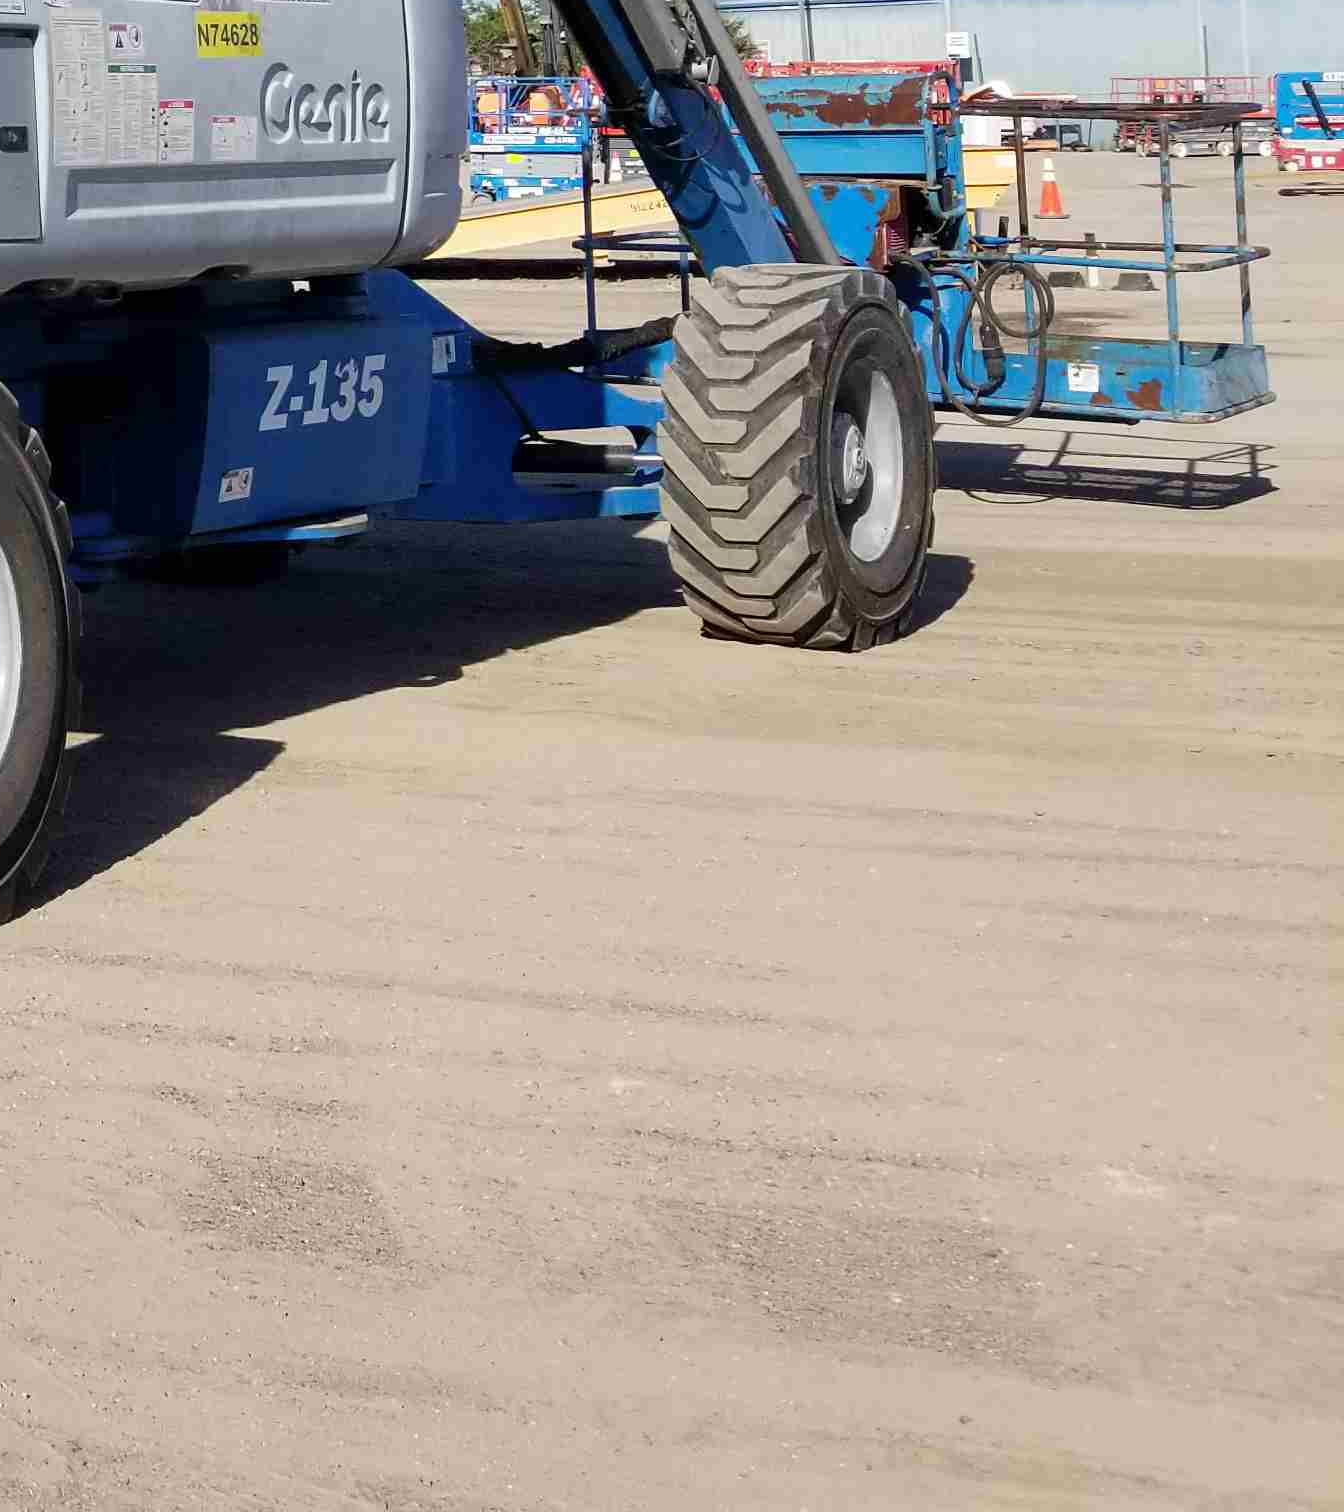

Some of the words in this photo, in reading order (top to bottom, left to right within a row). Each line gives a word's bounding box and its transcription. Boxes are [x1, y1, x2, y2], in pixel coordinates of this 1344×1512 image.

[197, 23, 259, 47] N74628
[260, 61, 390, 144] Genie
[258, 354, 387, 432] Z-135
